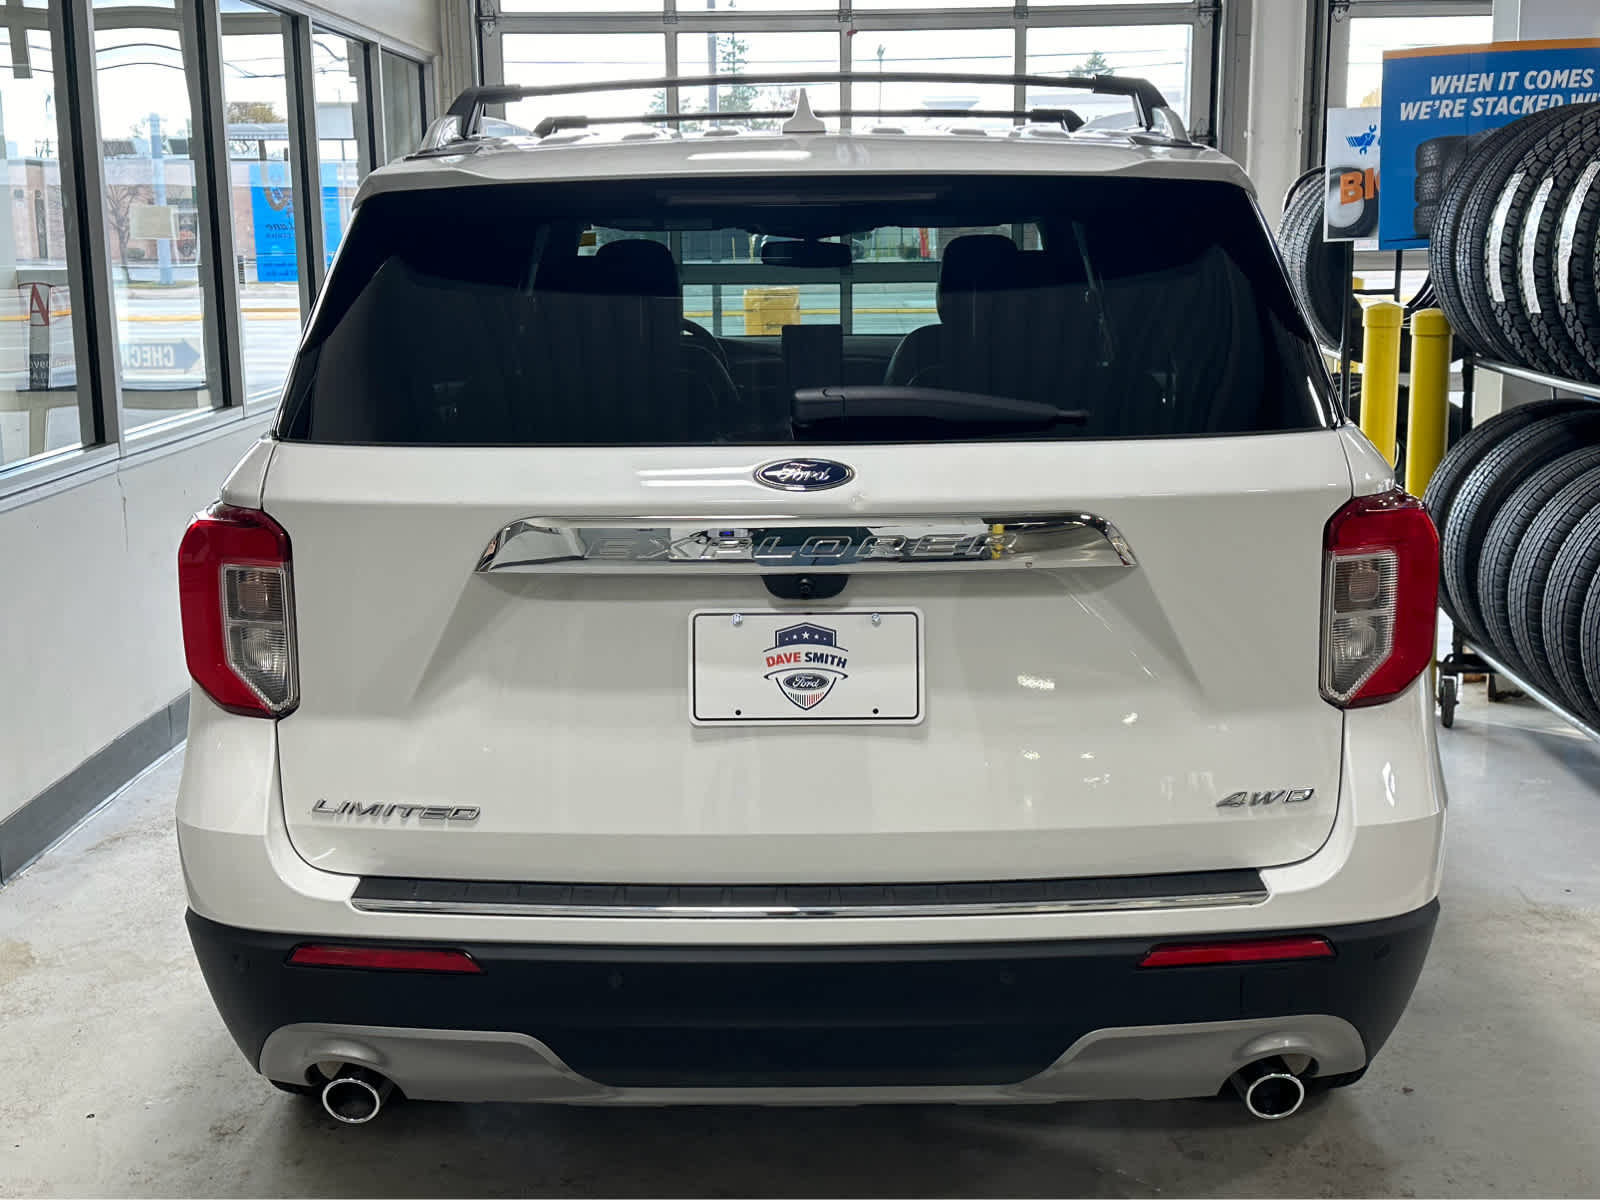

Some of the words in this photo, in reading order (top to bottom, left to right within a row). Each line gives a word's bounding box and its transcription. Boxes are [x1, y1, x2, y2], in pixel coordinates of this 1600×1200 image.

[1430, 72, 1495, 95] WHEN
[1498, 71, 1520, 91] IT
[1523, 68, 1595, 90] COMES
[1400, 97, 1466, 121] WE'RE
[1470, 93, 1564, 118] STACKED
[763, 462, 833, 482] Ford
[583, 533, 1018, 561] EXPLORER
[765, 651, 801, 668] DAVE
[804, 651, 848, 669] SMITH
[791, 675, 821, 689] Ford
[1216, 788, 1315, 808] 4WD
[311, 799, 481, 821] LIMITED
